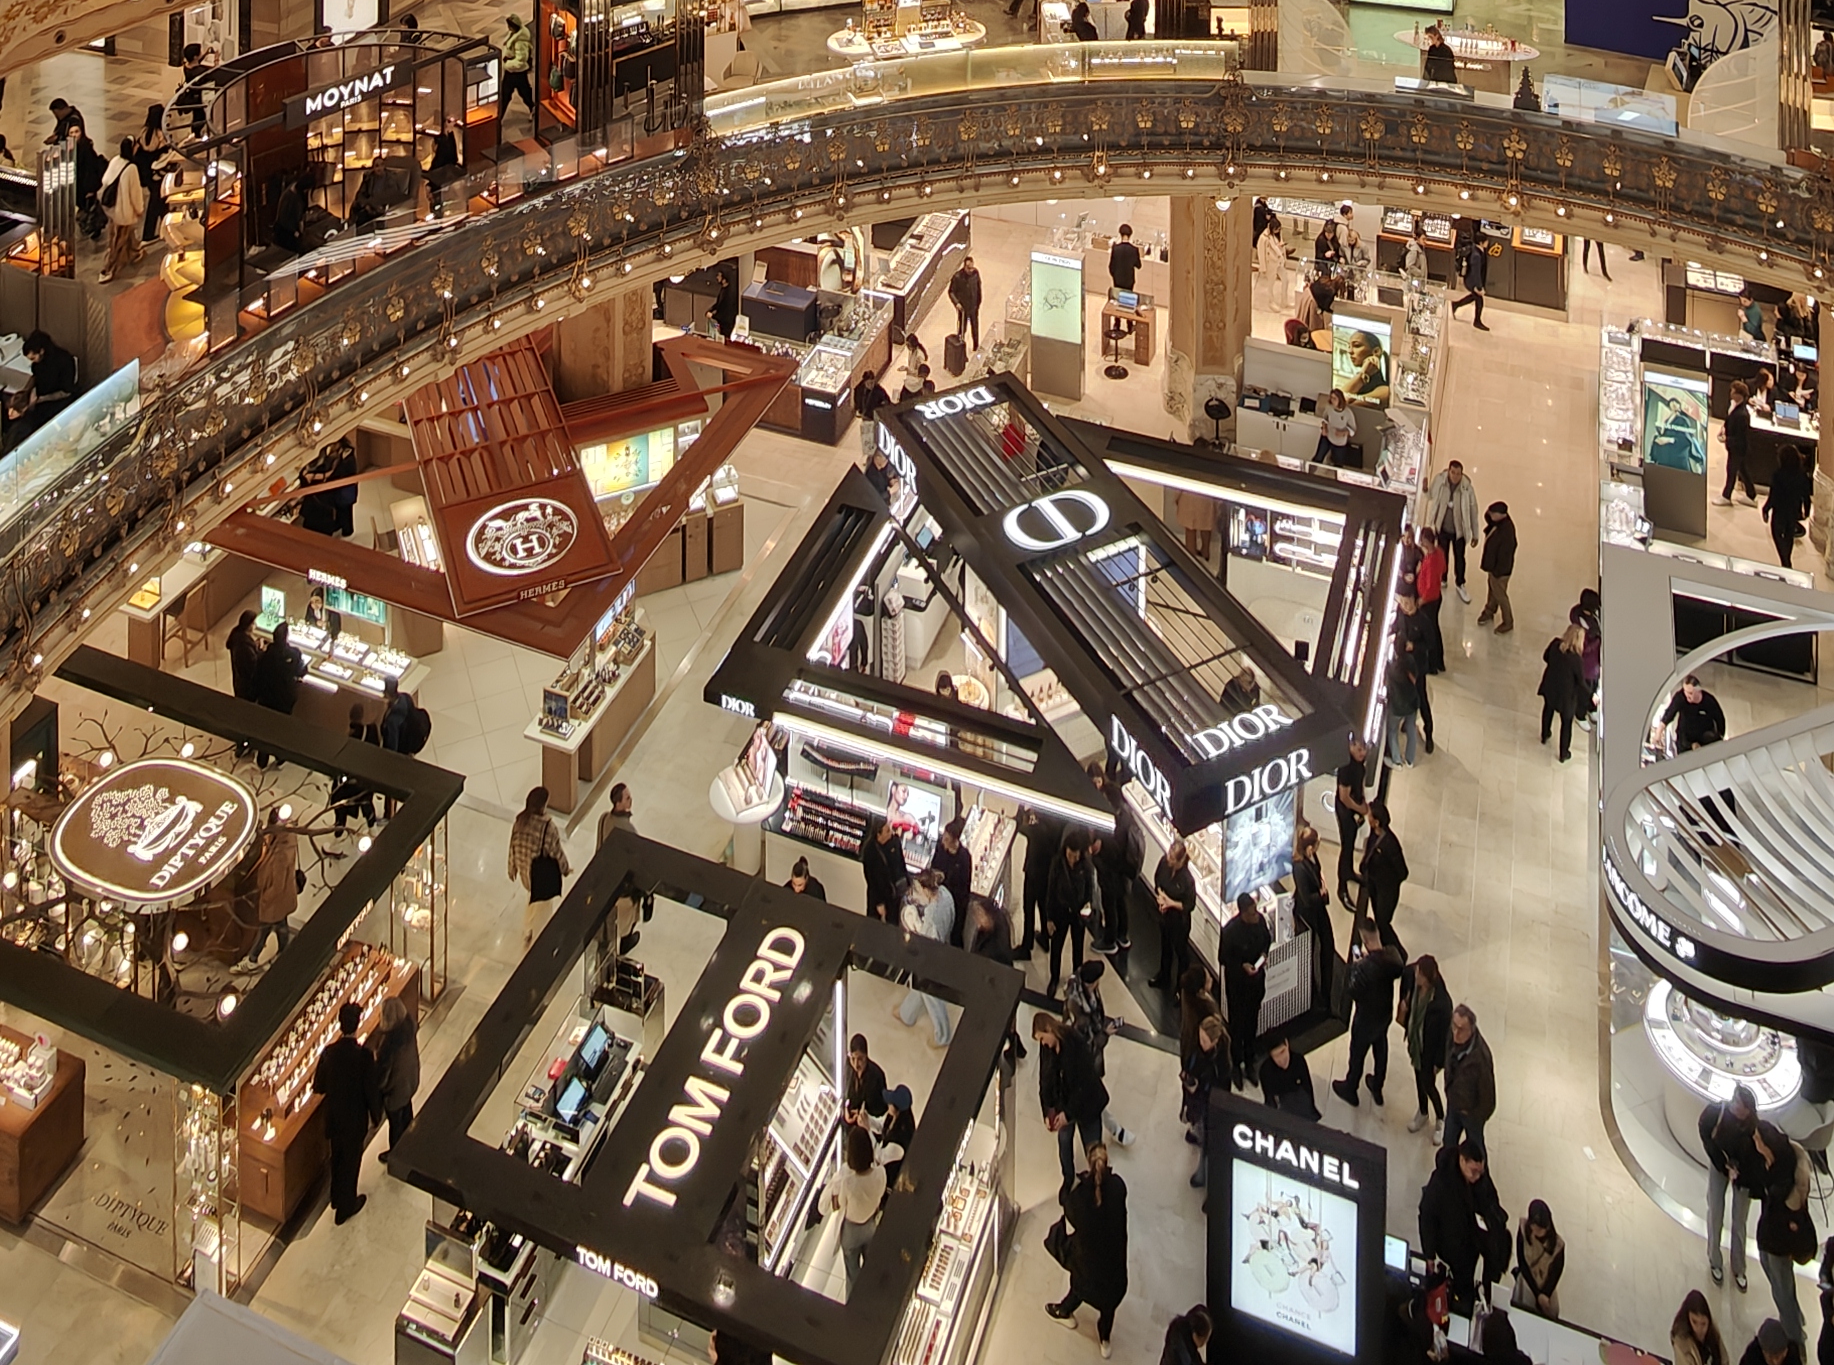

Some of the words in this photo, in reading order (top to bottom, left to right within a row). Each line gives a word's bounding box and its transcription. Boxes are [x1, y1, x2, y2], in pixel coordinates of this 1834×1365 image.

[305, 65, 395, 116] MOYNAT
[340, 94, 362, 109] PARIS
[914, 385, 996, 420] DIOR
[878, 421, 918, 494] DIOR
[721, 693, 755, 717] DIOR
[1193, 703, 1294, 759] DIOR
[1111, 713, 1173, 820] DIOR
[1225, 748, 1313, 816] DIOR
[148, 800, 239, 889] DIPTYQUE
[198, 835, 228, 865] PARIS
[622, 1075, 731, 1209] TOM
[700, 926, 805, 1076] FORD
[1232, 1123, 1360, 1191] CHANEL
[95, 1192, 169, 1237] DIPTYQUE
[576, 1243, 611, 1279] TOM
[613, 1261, 659, 1298] FORD
[1276, 1311, 1311, 1331] CHANEL
